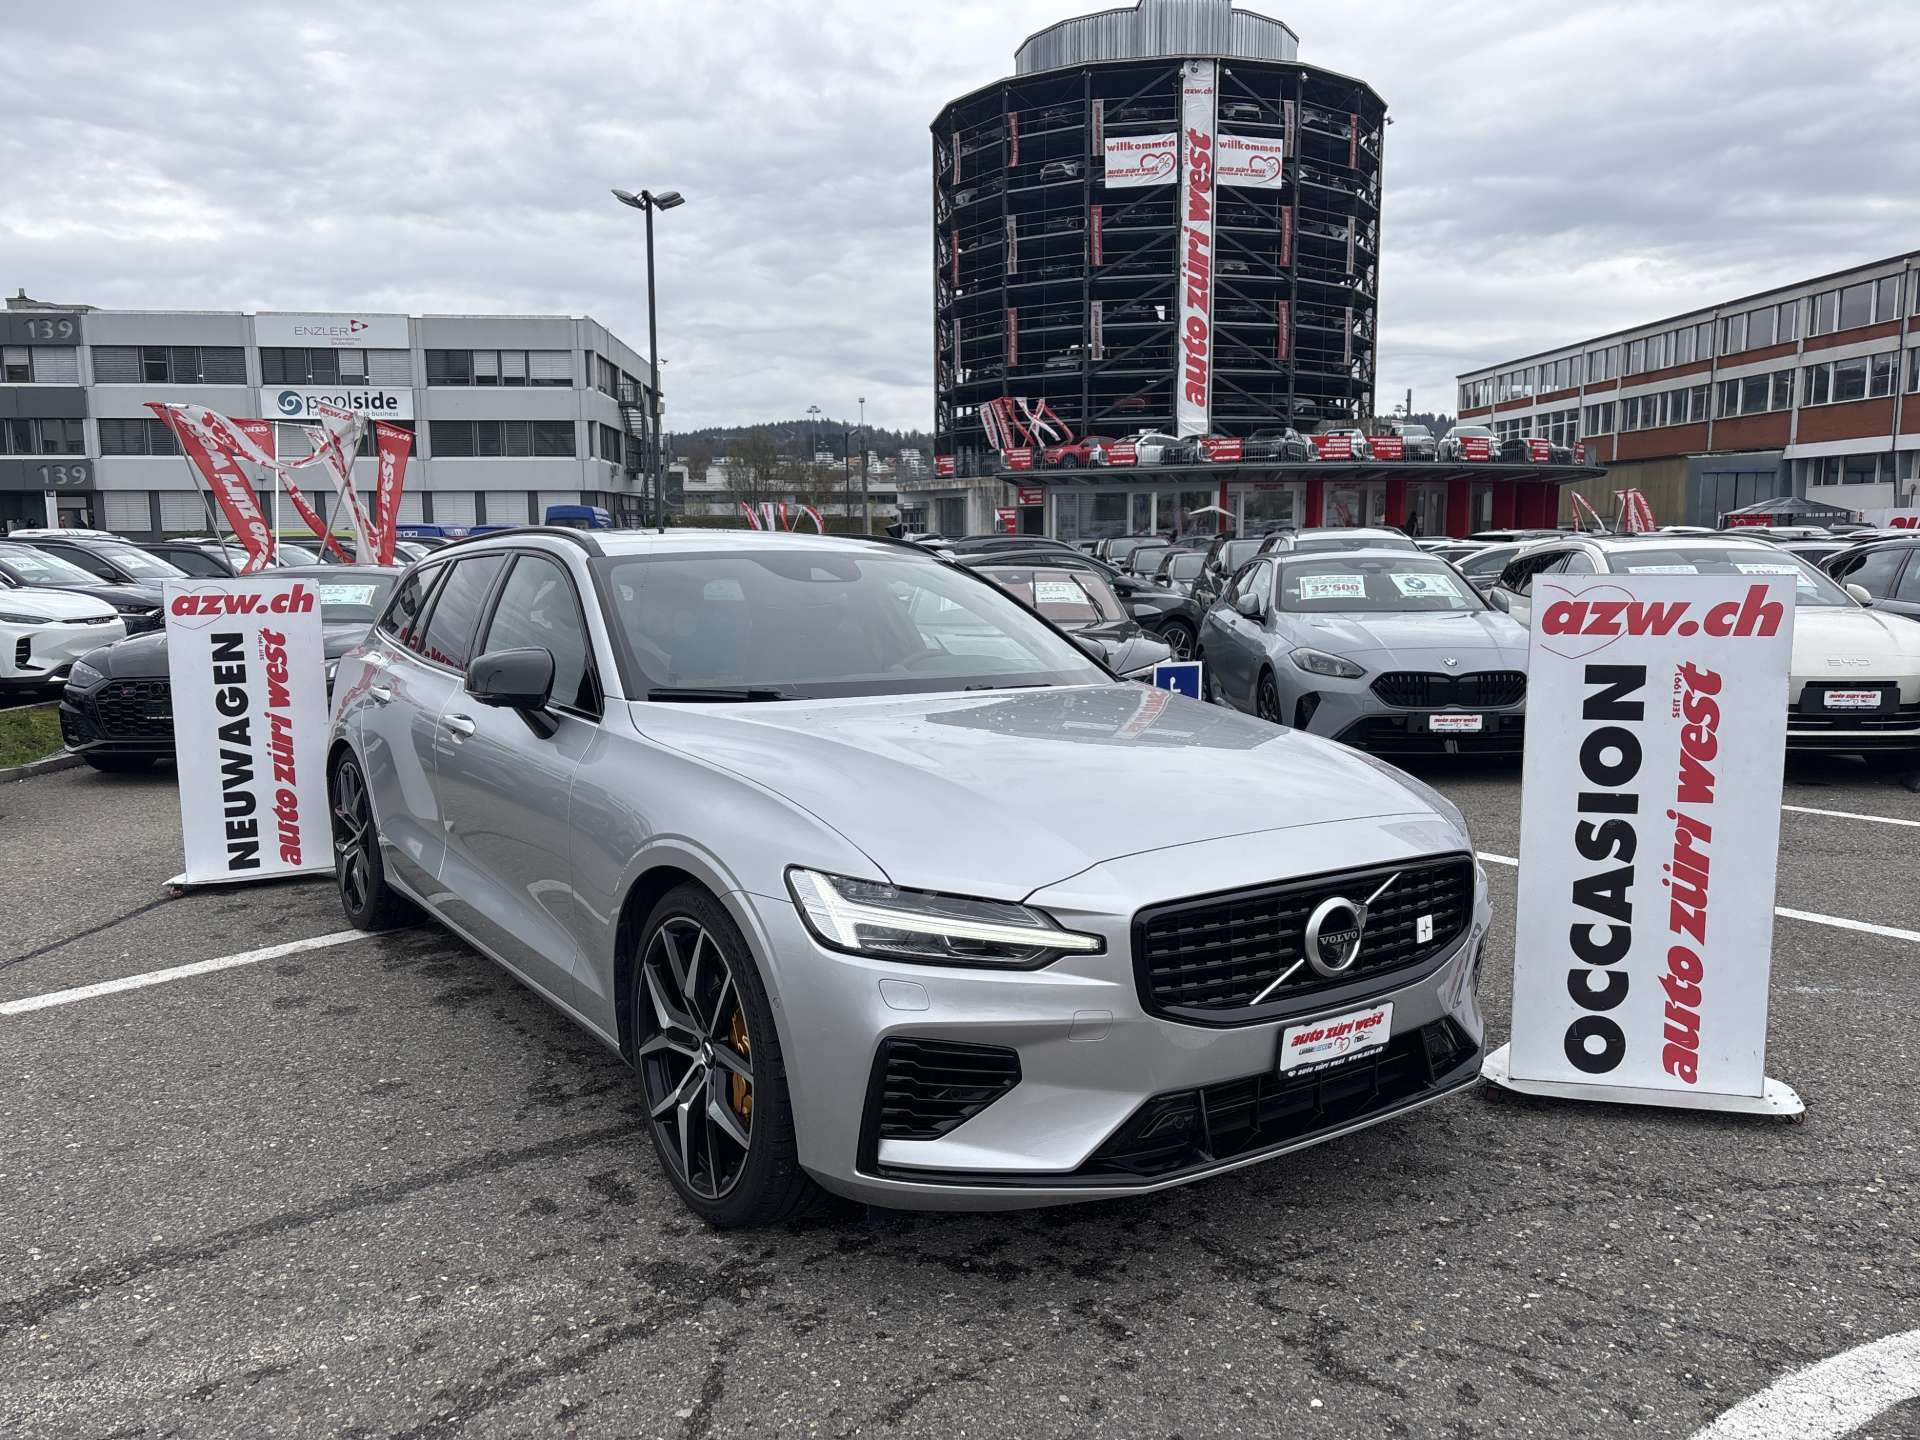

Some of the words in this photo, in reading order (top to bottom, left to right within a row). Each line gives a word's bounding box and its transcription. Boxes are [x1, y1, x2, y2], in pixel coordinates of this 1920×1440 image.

[1184, 86, 1214, 95] azw.ch
[1107, 140, 1175, 152] willkommen
[1219, 140, 1280, 152] willkommen
[1186, 127, 1211, 221] west
[1182, 226, 1210, 315] züri
[24, 319, 73, 339] 139
[294, 326, 349, 336] ENZLER
[1183, 316, 1208, 408] auto
[306, 391, 398, 415] poolside
[37, 464, 87, 485] 139
[214, 473, 262, 520] züri
[171, 584, 314, 616] azw.ch
[1541, 585, 1784, 637] azw.ch
[258, 628, 290, 708] west
[1673, 672, 1682, 696] 1991
[1672, 699, 1680, 718] SEIT
[210, 632, 260, 871] NEUWAGEN
[264, 712, 297, 787] züri
[1676, 661, 1722, 804] west
[272, 788, 302, 866] auto
[1564, 664, 1647, 1074] OCCASION
[1662, 808, 1713, 946] züri
[1319, 930, 1358, 945] VOLVO
[1291, 1029, 1324, 1047] auto
[1324, 1020, 1355, 1039] züri
[1355, 1012, 1385, 1031] west
[1657, 945, 1705, 1084] auto
[1297, 1067, 1313, 1076] auto
[1314, 1061, 1330, 1071] züri
[1330, 1057, 1346, 1066] west
